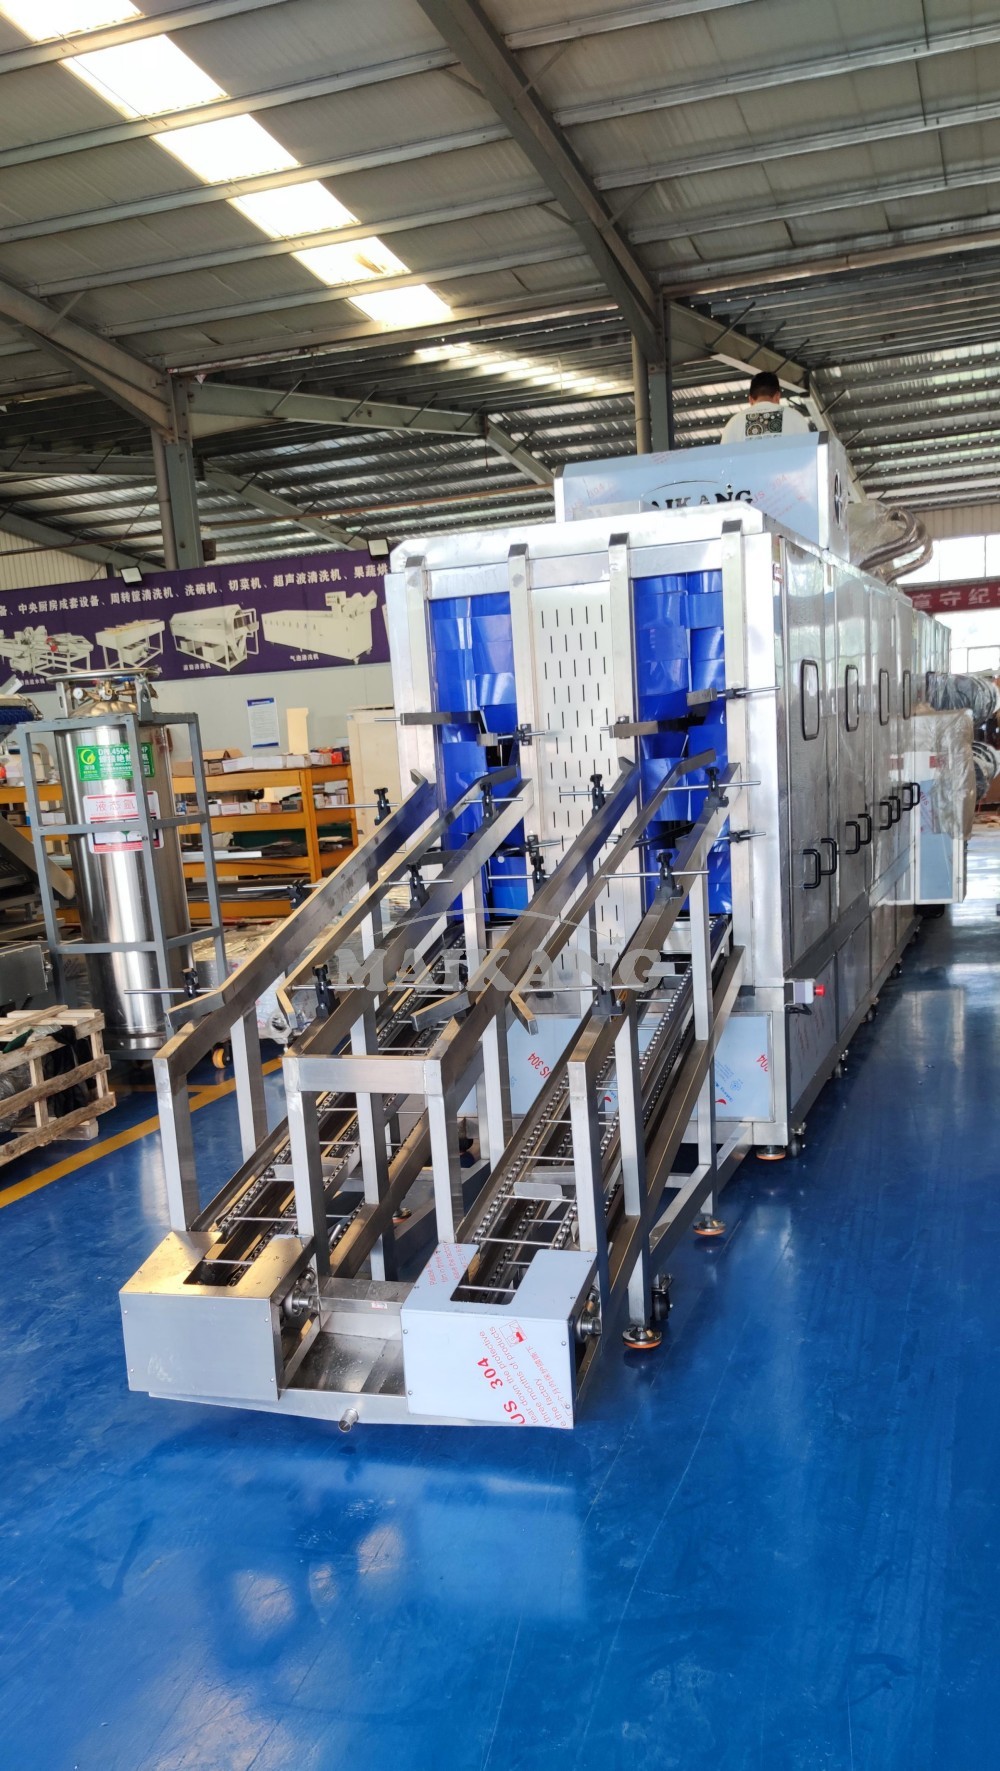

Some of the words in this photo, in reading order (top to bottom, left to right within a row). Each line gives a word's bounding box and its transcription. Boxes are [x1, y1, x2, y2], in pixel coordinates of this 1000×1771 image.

[528, 1052, 544, 1070] 304
[480, 1331, 506, 1370] protective
[489, 1326, 515, 1361] products
[477, 1357, 503, 1390] 304
[509, 1360, 519, 1370] of
[503, 1370, 513, 1385] the
[516, 1371, 538, 1401] months
[512, 1384, 529, 1406] down
[534, 1378, 552, 1406] factory
[526, 1405, 539, 1424] tear
[536, 1402, 552, 1423] three
[552, 1407, 562, 1424] the
